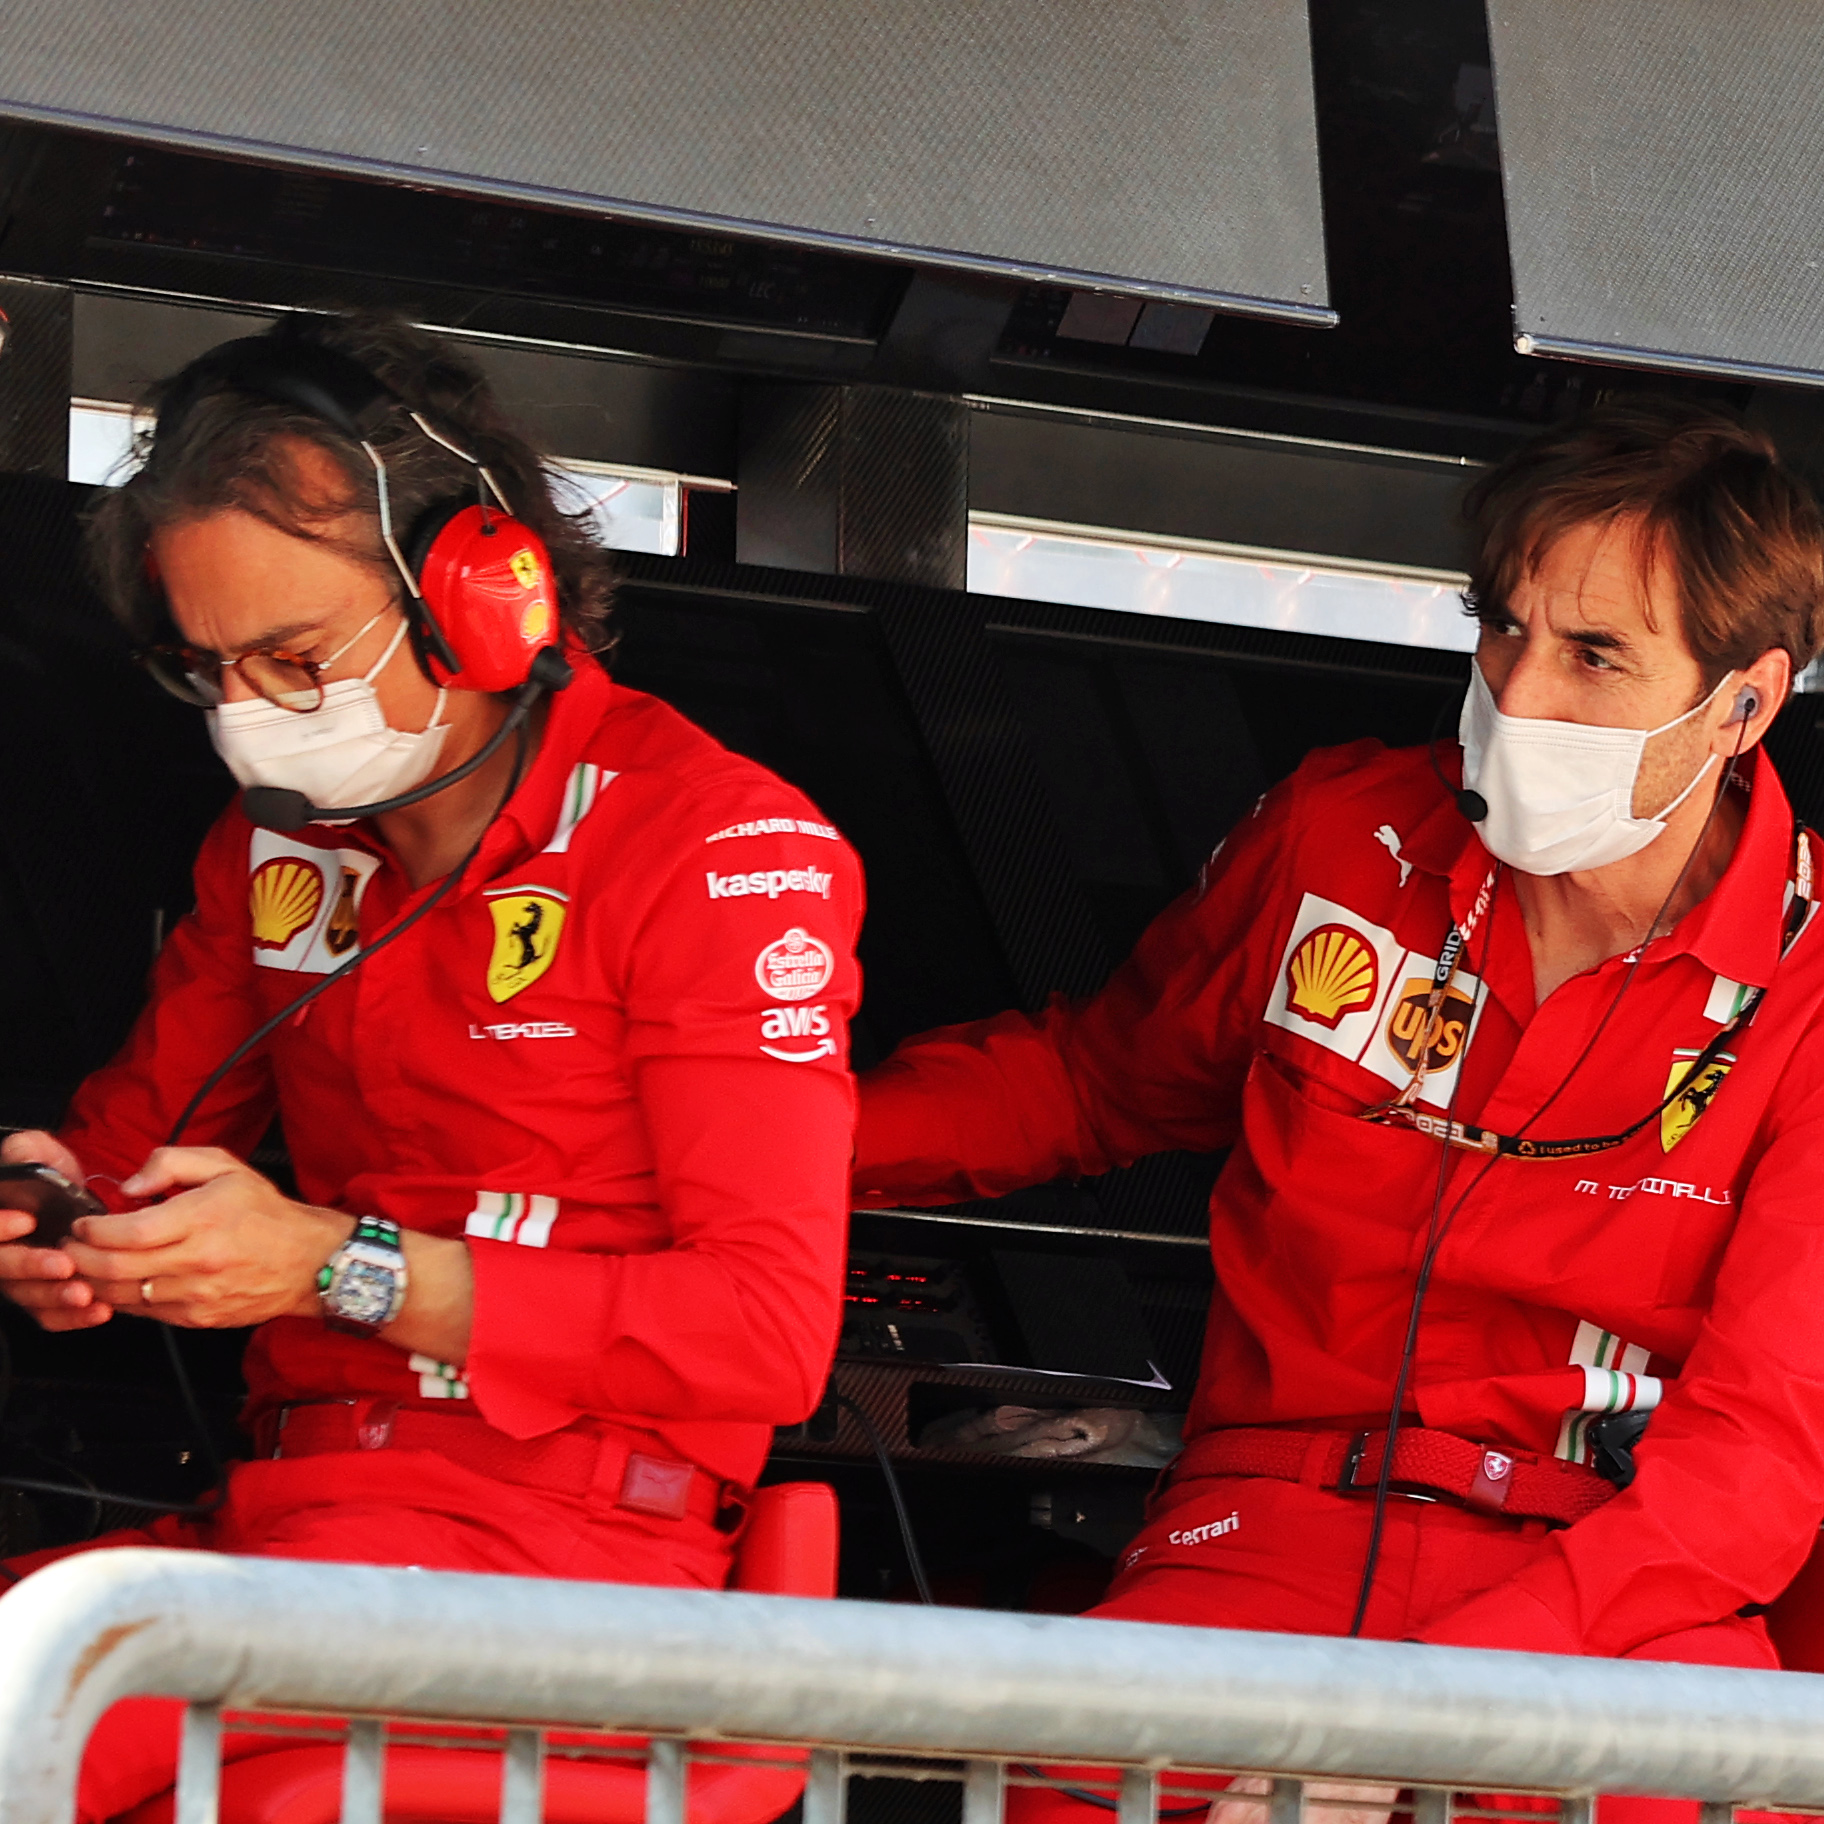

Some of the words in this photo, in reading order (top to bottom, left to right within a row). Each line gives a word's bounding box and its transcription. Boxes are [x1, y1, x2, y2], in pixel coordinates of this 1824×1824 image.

[705, 818, 796, 844] RICHARD
[796, 820, 841, 841] MILLE
[705, 865, 833, 900] kaspersky
[760, 1004, 831, 1039] aws
[1391, 1001, 1465, 1060] ups
